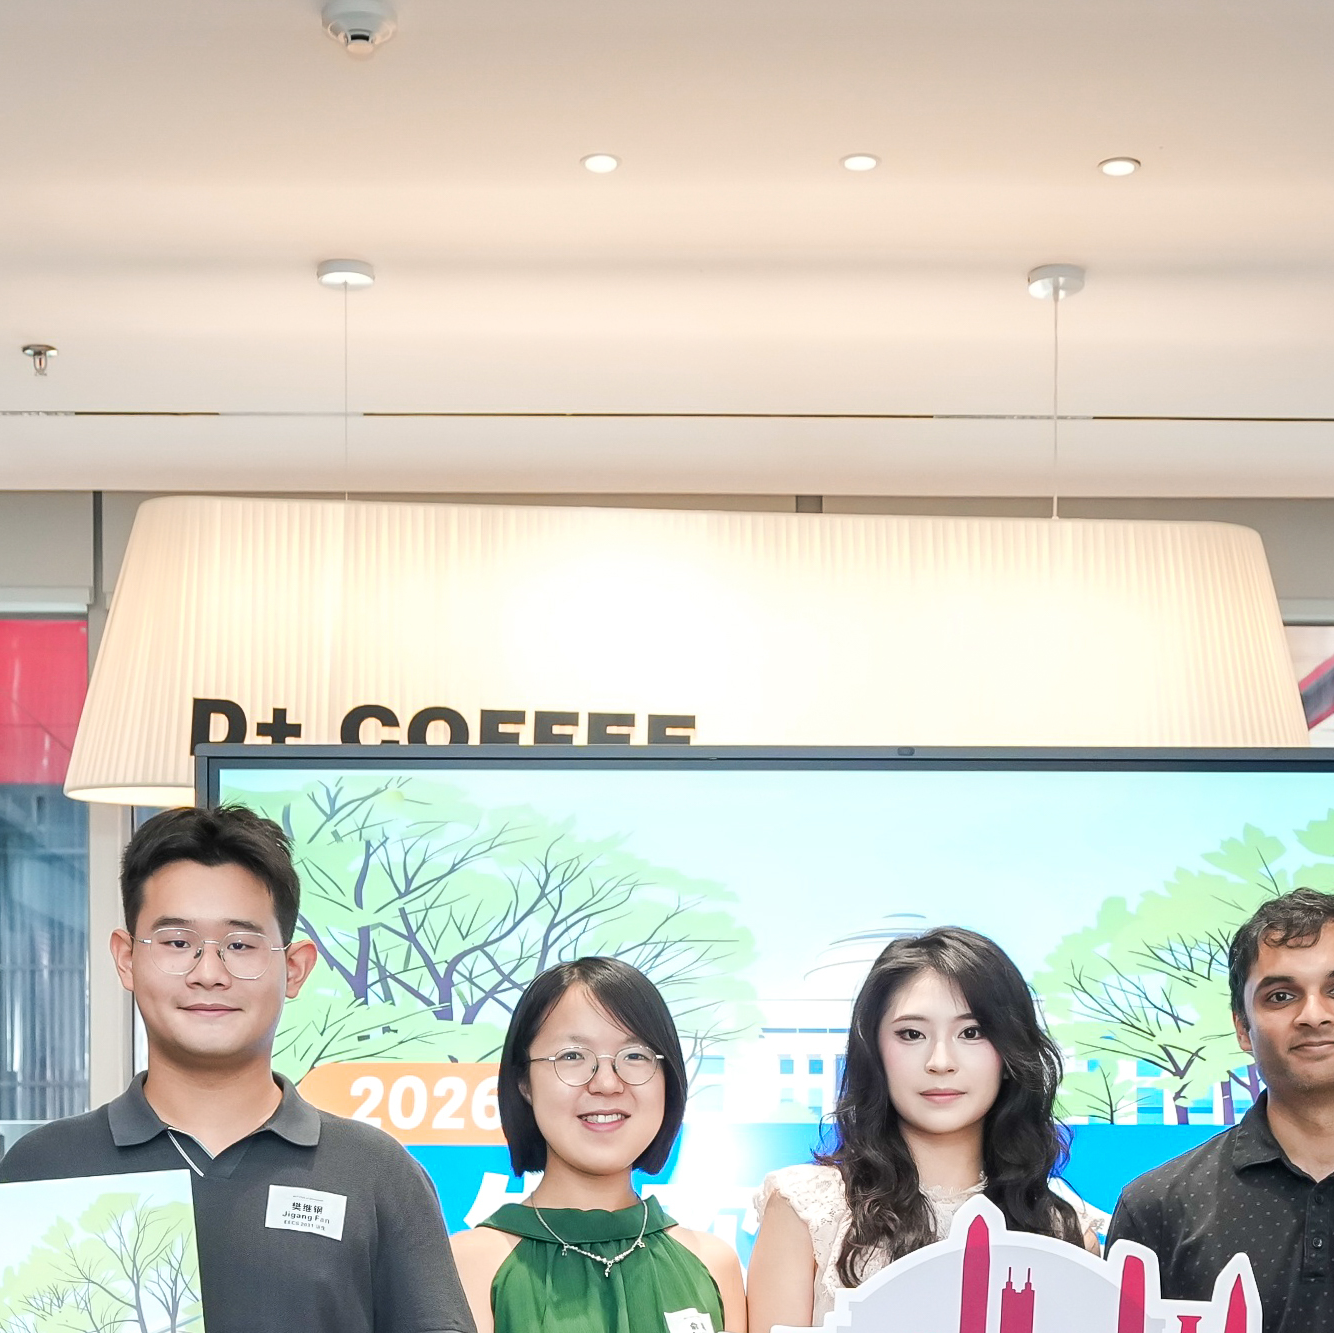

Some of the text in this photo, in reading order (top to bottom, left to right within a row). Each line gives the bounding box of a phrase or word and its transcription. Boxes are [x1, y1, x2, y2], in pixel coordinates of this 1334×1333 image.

[190, 697, 302, 755] D+
[350, 1075, 501, 1130] 2026
[282, 1210, 330, 1225] Jigang Fan
